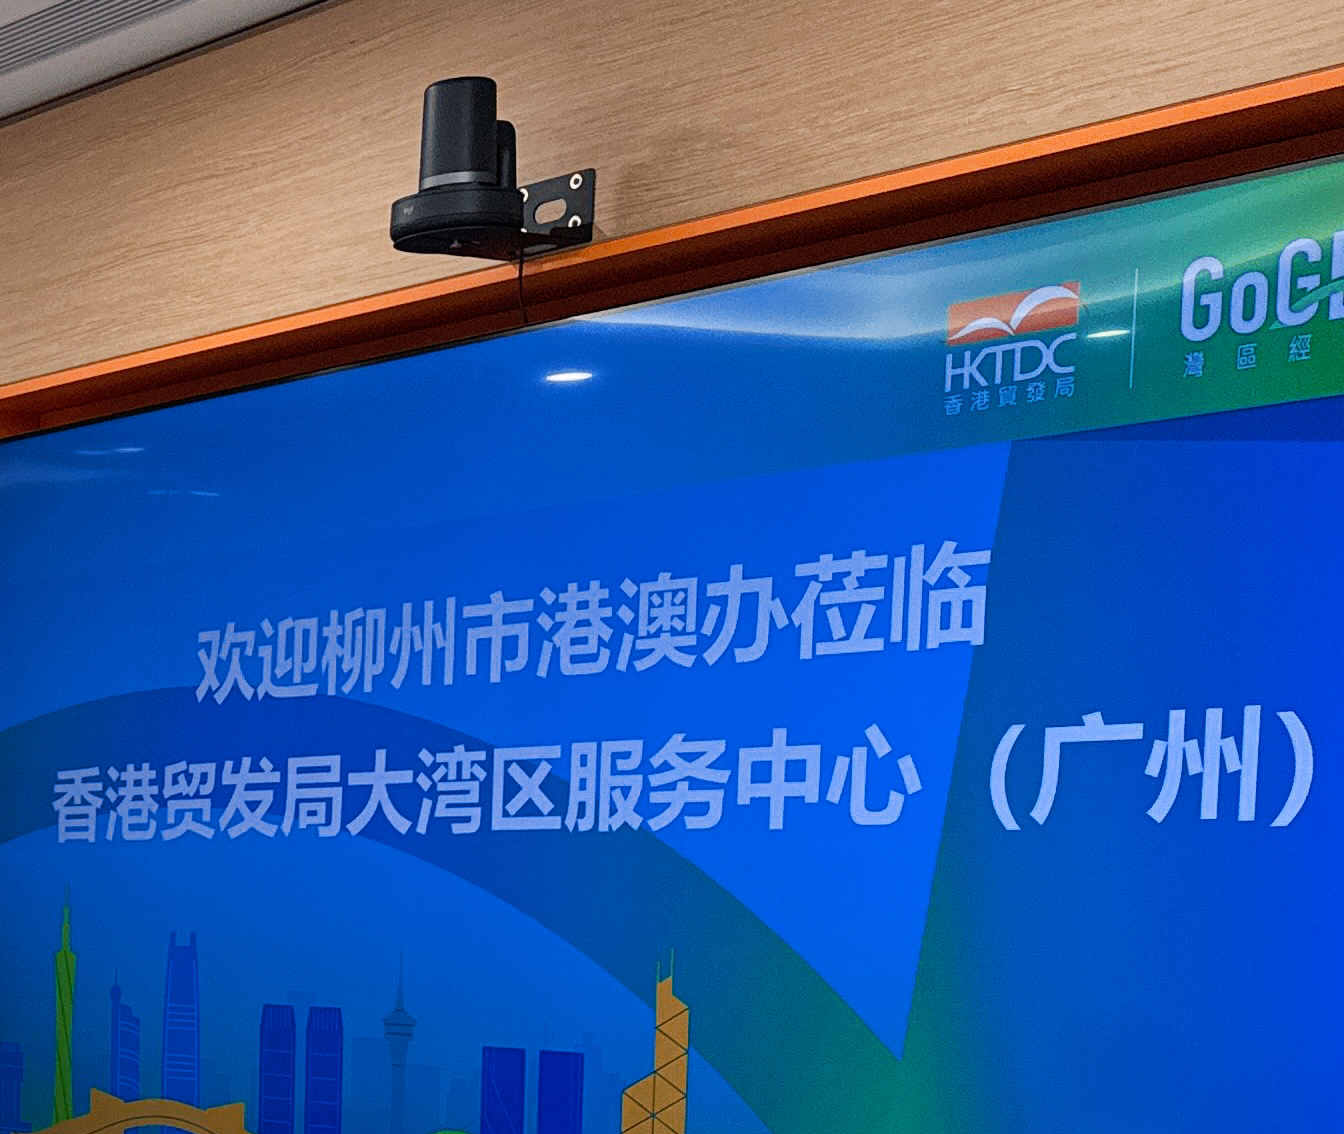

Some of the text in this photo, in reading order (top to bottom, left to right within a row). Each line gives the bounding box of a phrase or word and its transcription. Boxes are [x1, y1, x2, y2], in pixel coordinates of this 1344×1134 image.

[1180, 230, 1344, 342] GoG
[943, 375, 1076, 416] 香港貿發局
[944, 332, 1078, 393] HKTDC
[196, 540, 992, 705] 欢迎柳州市港澳办莅临
